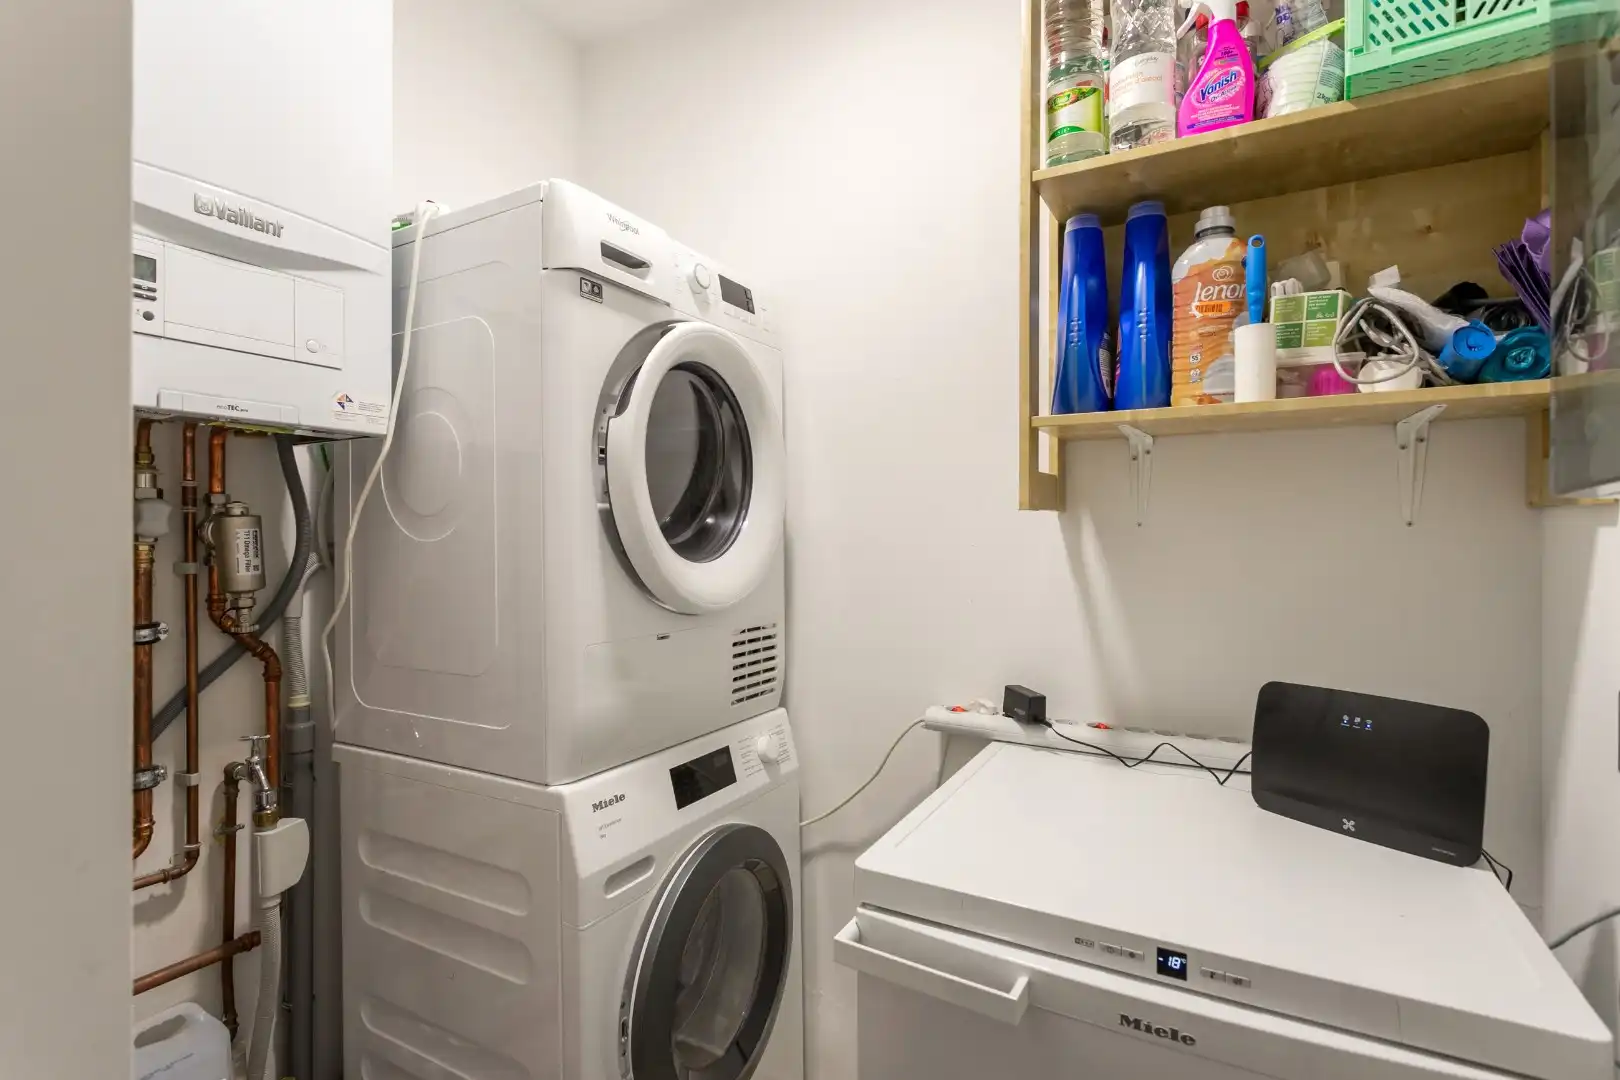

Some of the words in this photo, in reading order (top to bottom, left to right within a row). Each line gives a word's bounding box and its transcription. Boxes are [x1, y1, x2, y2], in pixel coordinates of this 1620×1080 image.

[1200, 70, 1238, 101] Vanish
[213, 196, 284, 238] Vaillant
[606, 212, 640, 236] Whirlpool
[591, 793, 626, 813] Miele
[1118, 1013, 1197, 1047] Miele
